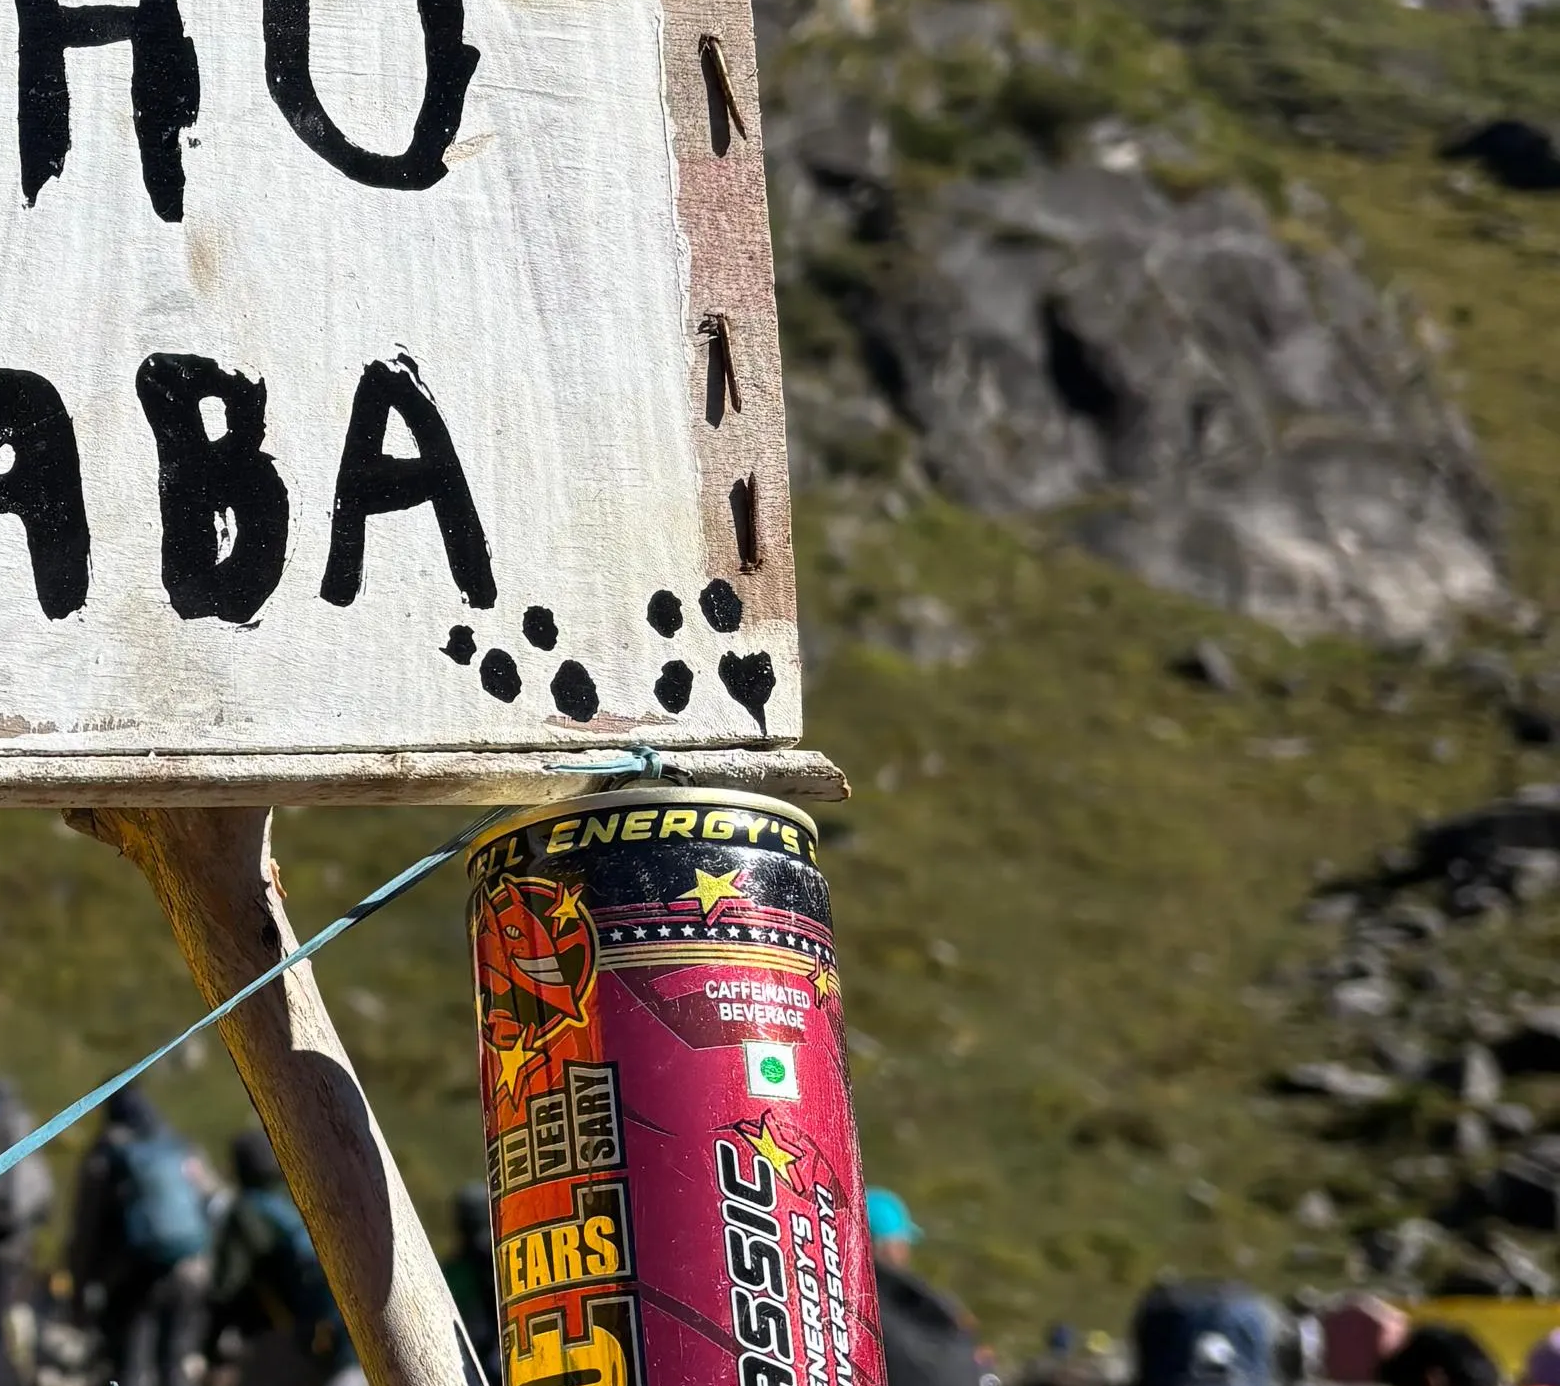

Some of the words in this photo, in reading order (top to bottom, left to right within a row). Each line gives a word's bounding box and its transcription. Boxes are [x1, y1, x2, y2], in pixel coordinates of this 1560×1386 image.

[546, 810, 801, 854] ENERGY'S
[705, 980, 811, 1009] CAFFEINATED
[719, 1002, 806, 1030] BEVERAGE
[535, 1099, 567, 1175] VER
[575, 1074, 616, 1161] SARY
